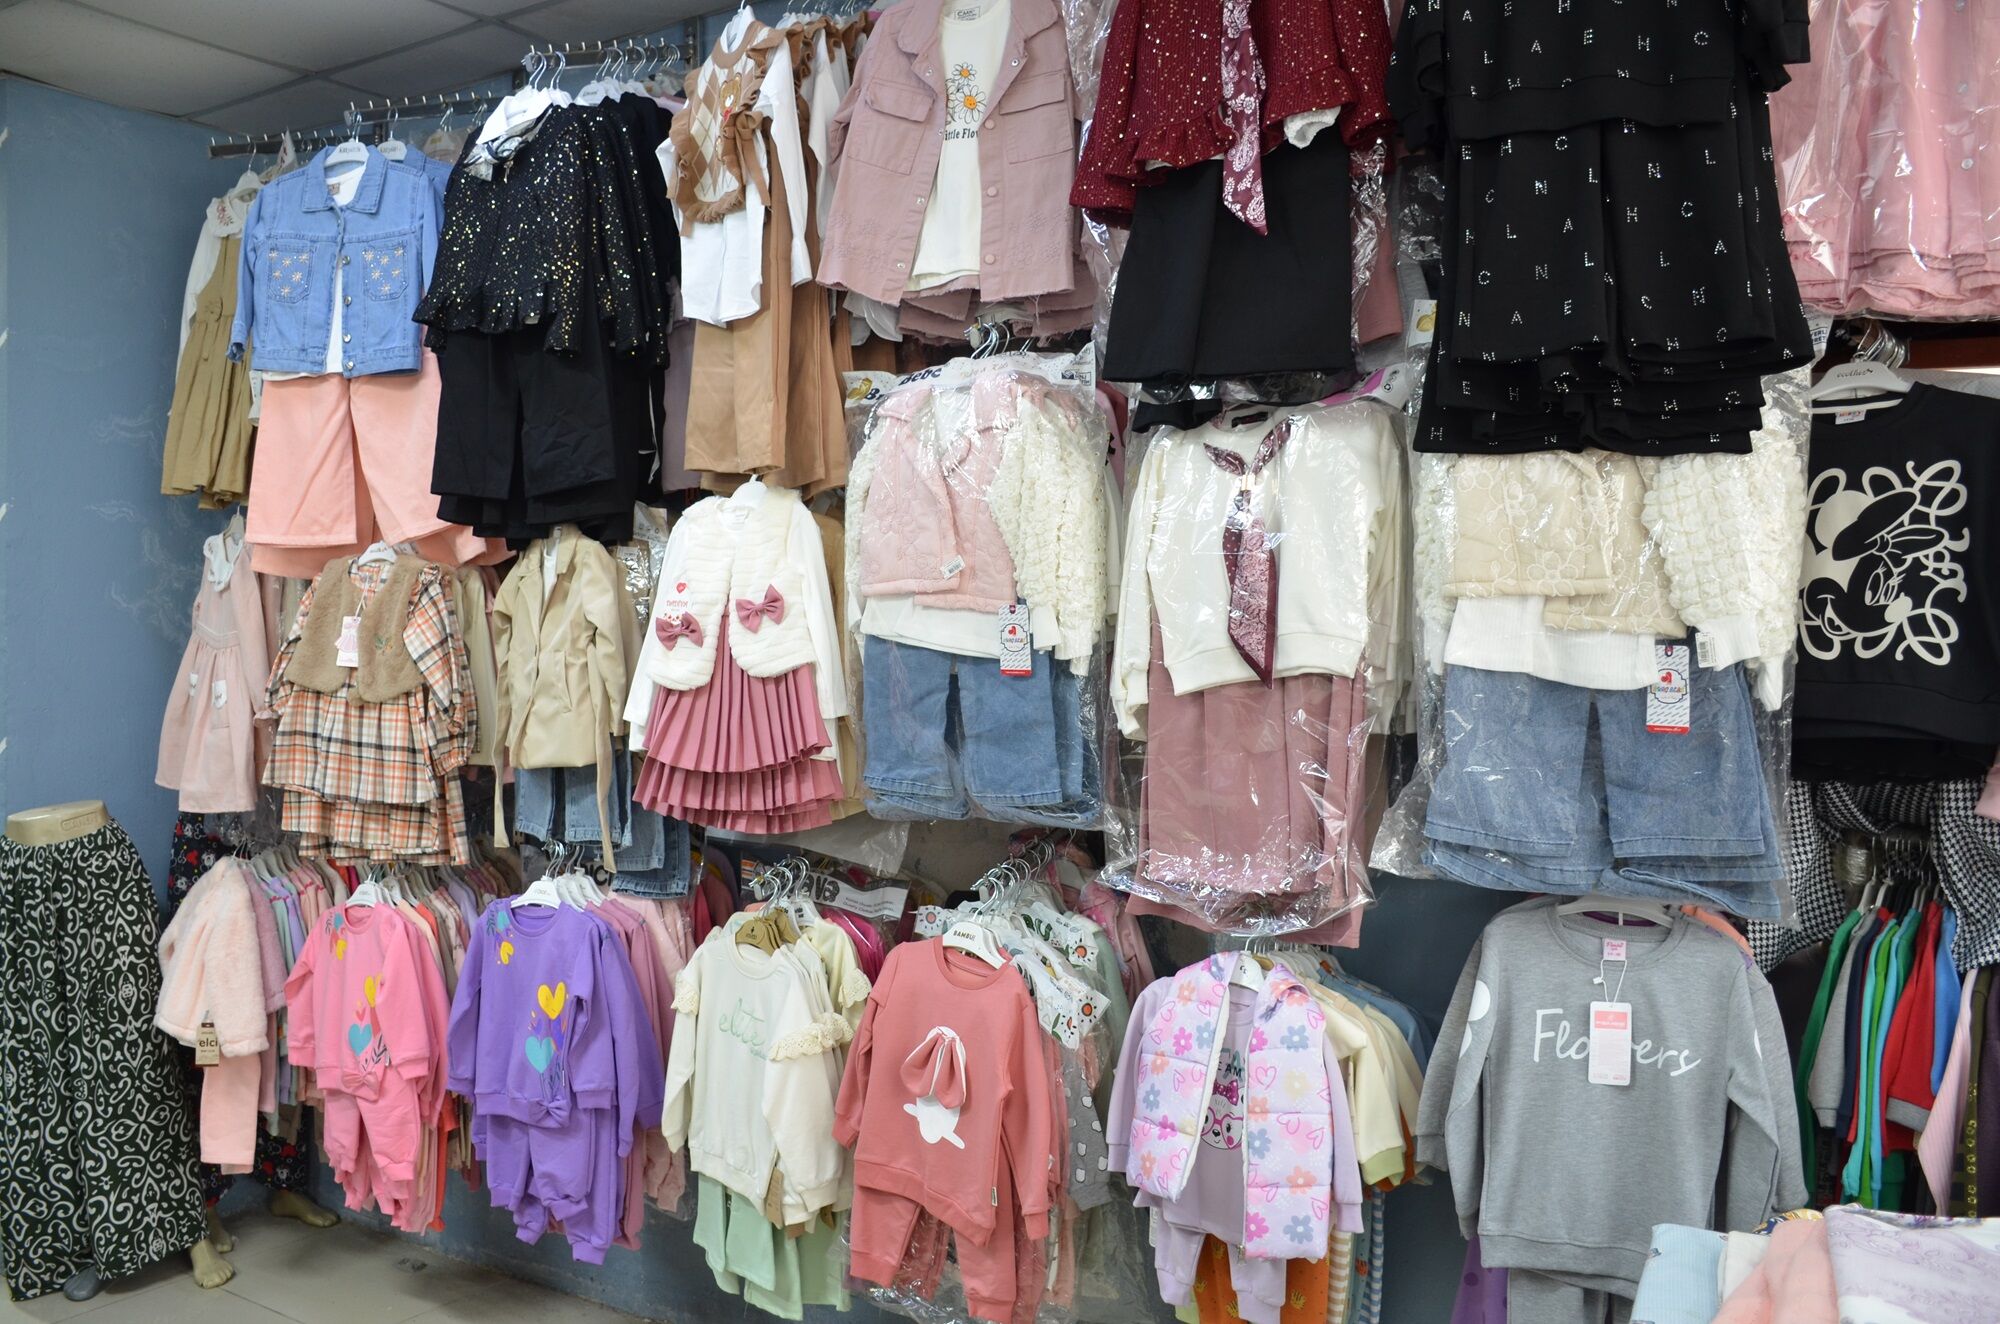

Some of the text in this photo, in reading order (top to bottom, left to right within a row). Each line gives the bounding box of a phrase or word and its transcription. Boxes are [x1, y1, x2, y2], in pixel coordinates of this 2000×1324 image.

[1408, 5, 1417, 18] A
[1463, 10, 1472, 22] A
[1584, 29, 1592, 44] E
[1638, 36, 1650, 51] H
[1694, 31, 1708, 45] C
[1531, 40, 1542, 53] A
[1484, 51, 1493, 64] L
[944, 129, 960, 141] ittle
[1501, 139, 1512, 156] H
[1555, 136, 1567, 150] C
[1462, 146, 1471, 160] E
[1705, 150, 1716, 164] L
[1589, 168, 1598, 183] L
[1648, 163, 1661, 178] N
[1535, 181, 1547, 194] N
[1485, 189, 1494, 203] C
[1627, 207, 1638, 222] H
[1681, 202, 1693, 217] C
[1507, 224, 1517, 239] L
[1563, 219, 1573, 232] A
[1714, 240, 1727, 254] A
[1585, 252, 1594, 266] L
[1660, 251, 1669, 267] L
[1478, 271, 1490, 284] C
[1536, 264, 1548, 279] N
[1564, 300, 1571, 315] E
[1641, 296, 1652, 309] C
[1459, 312, 1470, 327] N
[1511, 311, 1522, 324] A
[1717, 328, 1726, 342] C
[1463, 381, 1470, 395] E
[1509, 388, 1518, 400] H
[1431, 427, 1443, 440] H
[1533, 1007, 1702, 1078] Floers
